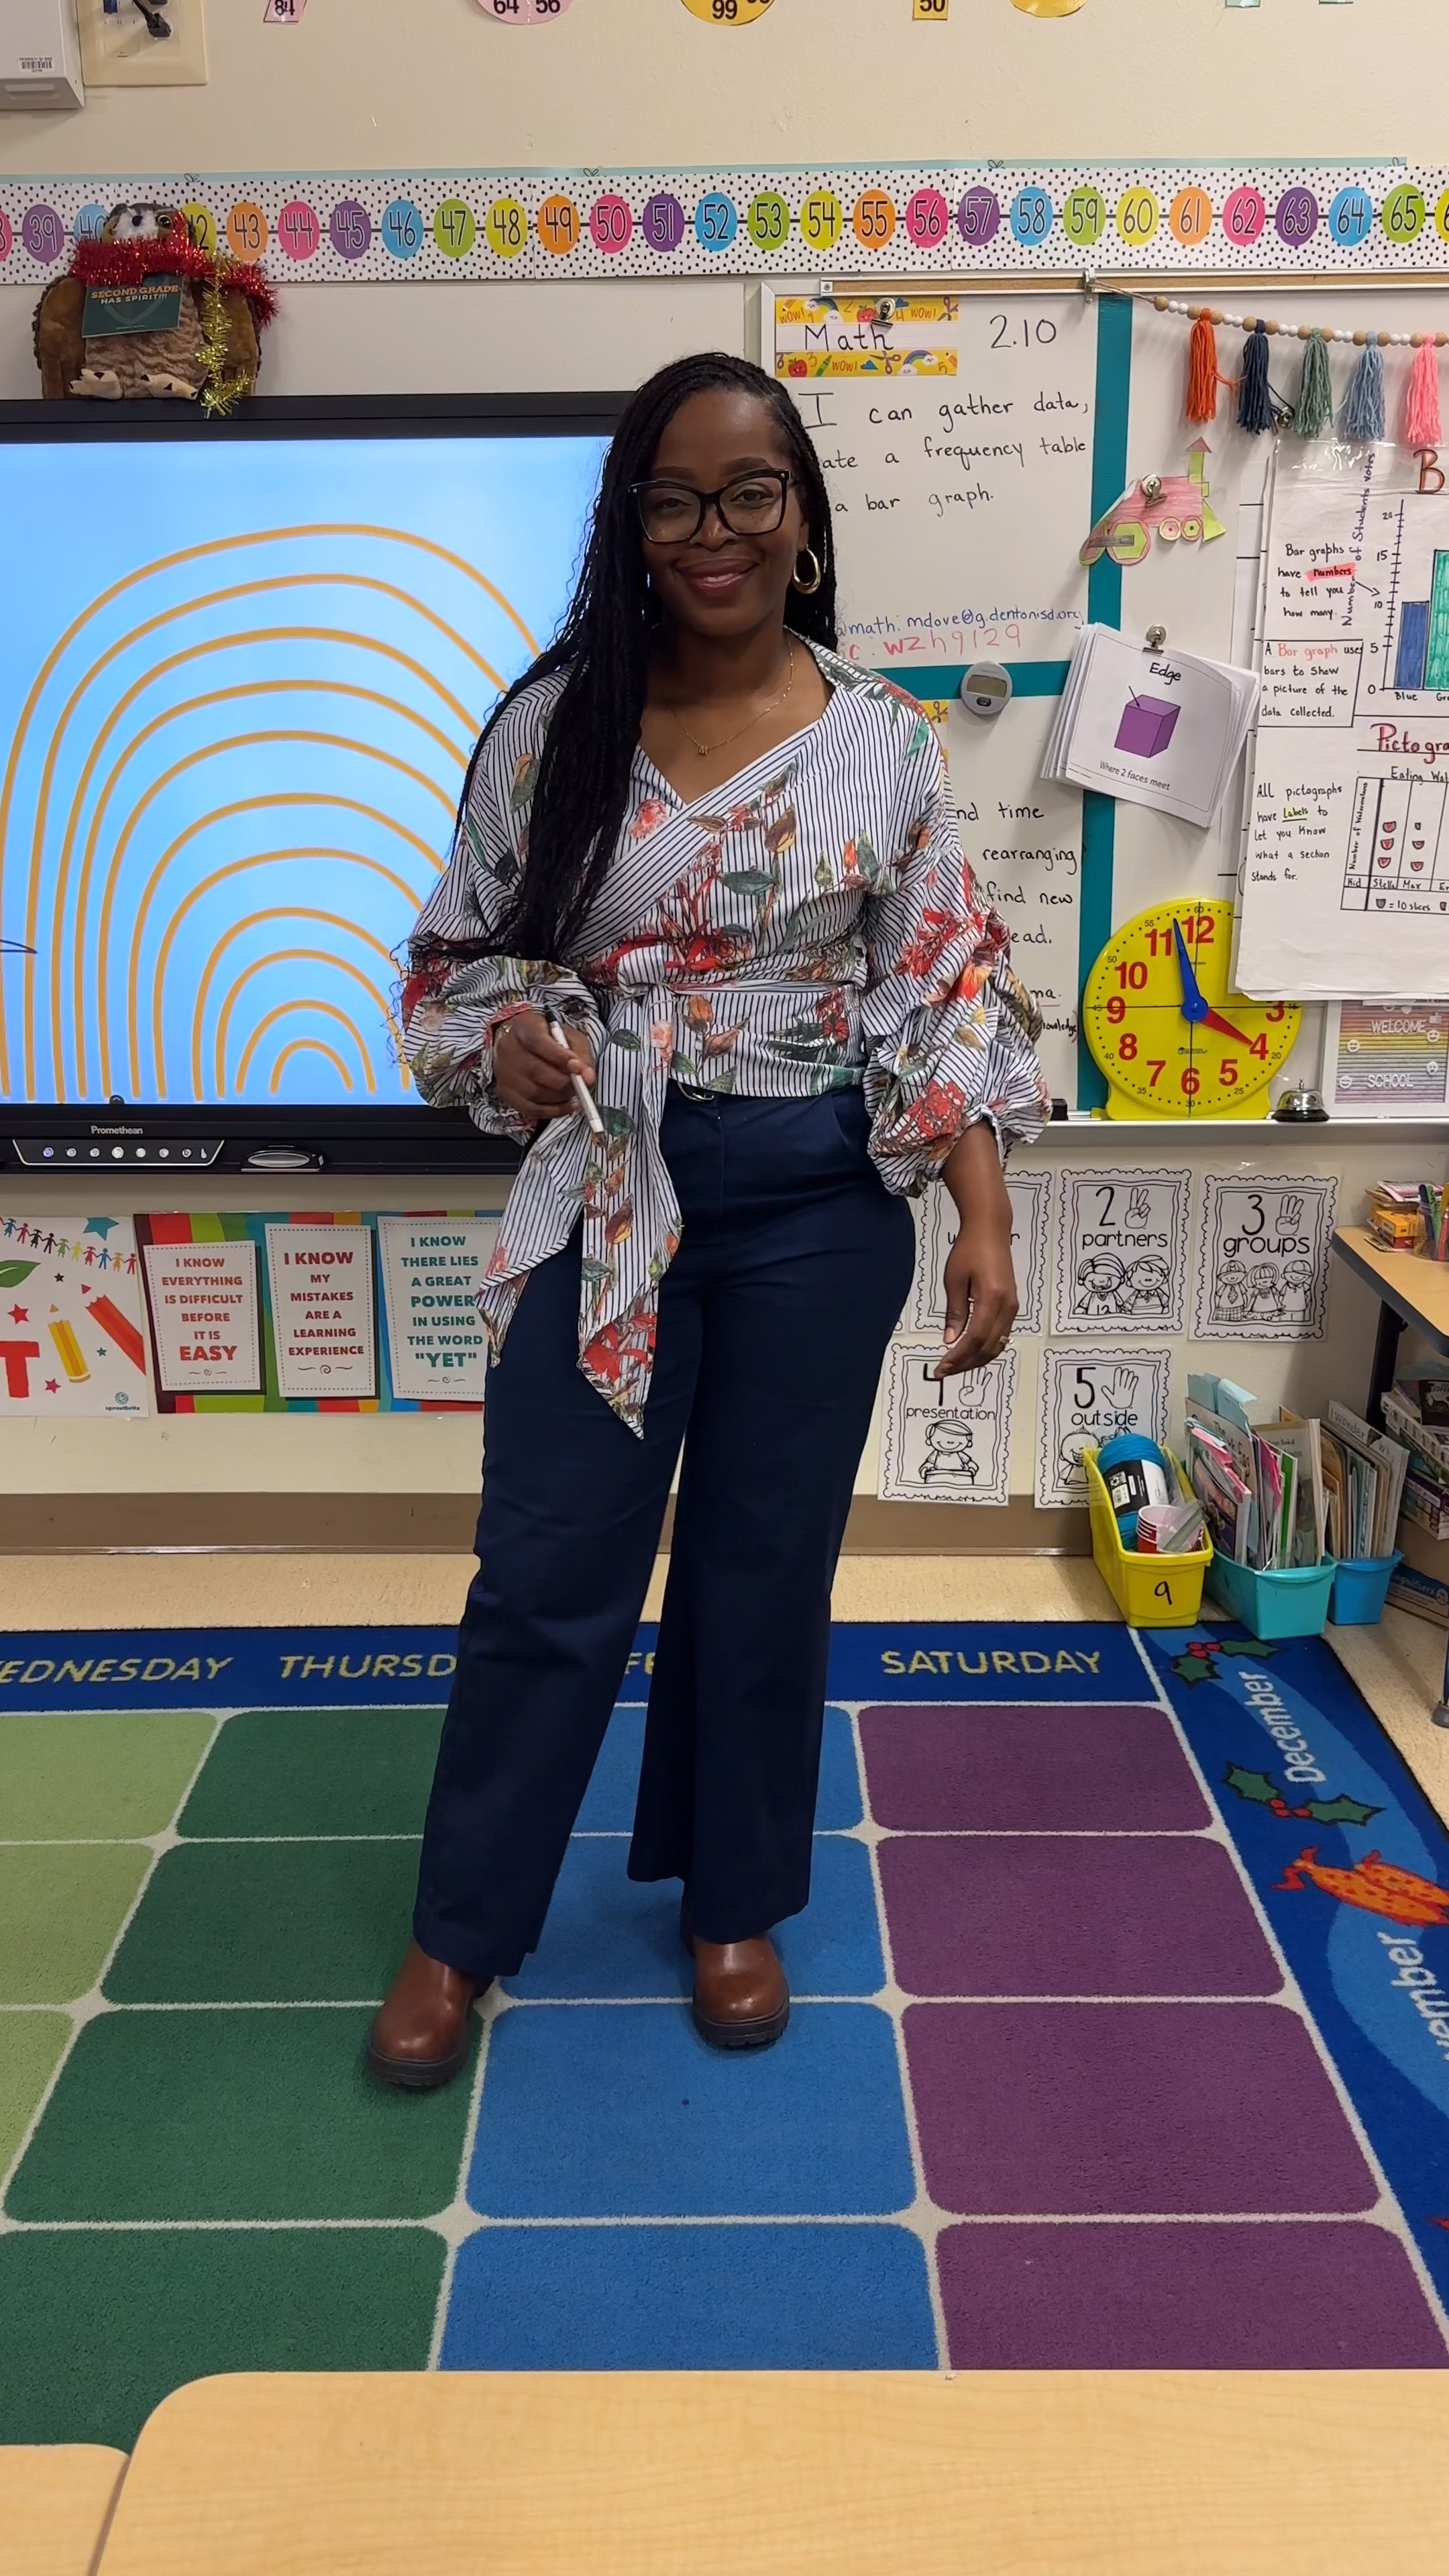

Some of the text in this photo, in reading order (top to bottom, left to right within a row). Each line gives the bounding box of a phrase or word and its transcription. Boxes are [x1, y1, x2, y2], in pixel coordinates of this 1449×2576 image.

[712, 0, 737, 19] 99
[30, 195, 1419, 252] 39 43 44 45 46 47 48 49 50 51 52 53 54 55 56 57 58 59 60 61 62 63 64 65
[91, 285, 178, 299] SECOND GRADE
[125, 293, 167, 302] SPIRIT!!!
[911, 308, 936, 318] WOW!
[805, 323, 894, 352] Math
[989, 315, 1057, 349] 2.10
[832, 360, 857, 372] WOW!
[798, 391, 1089, 433] I can gather data,
[885, 435, 1086, 470] a frequency table
[835, 482, 994, 517] a bar graph.
[1352, 488, 1370, 542] Students
[1285, 543, 1344, 562] Bar graphs
[1377, 550, 1387, 561] 15
[1278, 566, 1352, 578] have numbers
[1280, 586, 1344, 598] to tell you
[1283, 607, 1303, 617] how
[1265, 642, 1362, 661] A Bar graph uses
[1370, 643, 1379, 654] 5
[1149, 662, 1181, 685] Edge
[1264, 665, 1304, 676] bars to
[1274, 683, 1348, 697] picture of the
[1395, 691, 1418, 702] Blue
[1261, 704, 1282, 716] data
[1369, 722, 1449, 765] Pictogra
[1099, 761, 1171, 790] Where 2 faces meet
[1391, 766, 1424, 786] Eating
[1256, 782, 1342, 802] All pictographs
[998, 802, 1044, 819] time
[1257, 805, 1328, 822] have to
[1254, 829, 1291, 841] let you
[982, 848, 1077, 875] rearranging
[1348, 877, 1421, 889] Kid Max
[987, 881, 1073, 905] find new
[1409, 902, 1430, 911] slices
[1181, 916, 1215, 944] 12
[1144, 928, 1173, 957] 11
[1114, 961, 1148, 989] 10
[1106, 996, 1126, 1024] 9
[1265, 1001, 1285, 1022] 3
[1372, 1020, 1426, 1034] WELCOME
[1118, 1033, 1138, 1061] 8
[1249, 1033, 1269, 1061] 4
[1146, 1061, 1166, 1087] 7
[1219, 1059, 1238, 1086] 5
[1181, 1067, 1199, 1095] 6
[1367, 1074, 1414, 1088] SCHOOL
[91, 1125, 144, 1136] Promethean
[1095, 1186, 1116, 1227] 2
[1242, 1194, 1266, 1236] 3
[419, 1236, 466, 1246] KNOW
[1081, 1232, 1168, 1250] partners
[1223, 1234, 1310, 1258] groups
[183, 1258, 225, 1268] KNOW
[284, 1252, 354, 1265] I KNOW
[401, 1256, 479, 1267] THERE LIES
[161, 1277, 243, 1286] EVERYTHING
[310, 1274, 330, 1283] MY
[411, 1275, 472, 1287] A GREAT
[164, 1295, 244, 1305] IS DIFFICULT
[290, 1292, 354, 1301] MISTAKES
[411, 1295, 475, 1307] POWER
[181, 1313, 231, 1322] BEFORE
[305, 1310, 342, 1320] ARE A
[413, 1316, 476, 1326] IN USING
[194, 1331, 221, 1340] IT IS
[293, 1328, 357, 1338] LEARNING
[407, 1335, 483, 1346] THE WORD
[179, 1346, 237, 1361] EASY
[288, 1346, 364, 1356] EXPERIENCE
[415, 1352, 477, 1368] "YET"
[922, 1362, 945, 1407] 4
[1073, 1366, 1095, 1409] 5
[906, 1406, 996, 1421] presentation
[1071, 1409, 1138, 1426] outside
[1154, 1580, 1173, 1605] 9
[0, 1650, 1101, 1683] EDNESDAY THURSD SATURDAY
[1238, 1671, 1327, 1782] December
